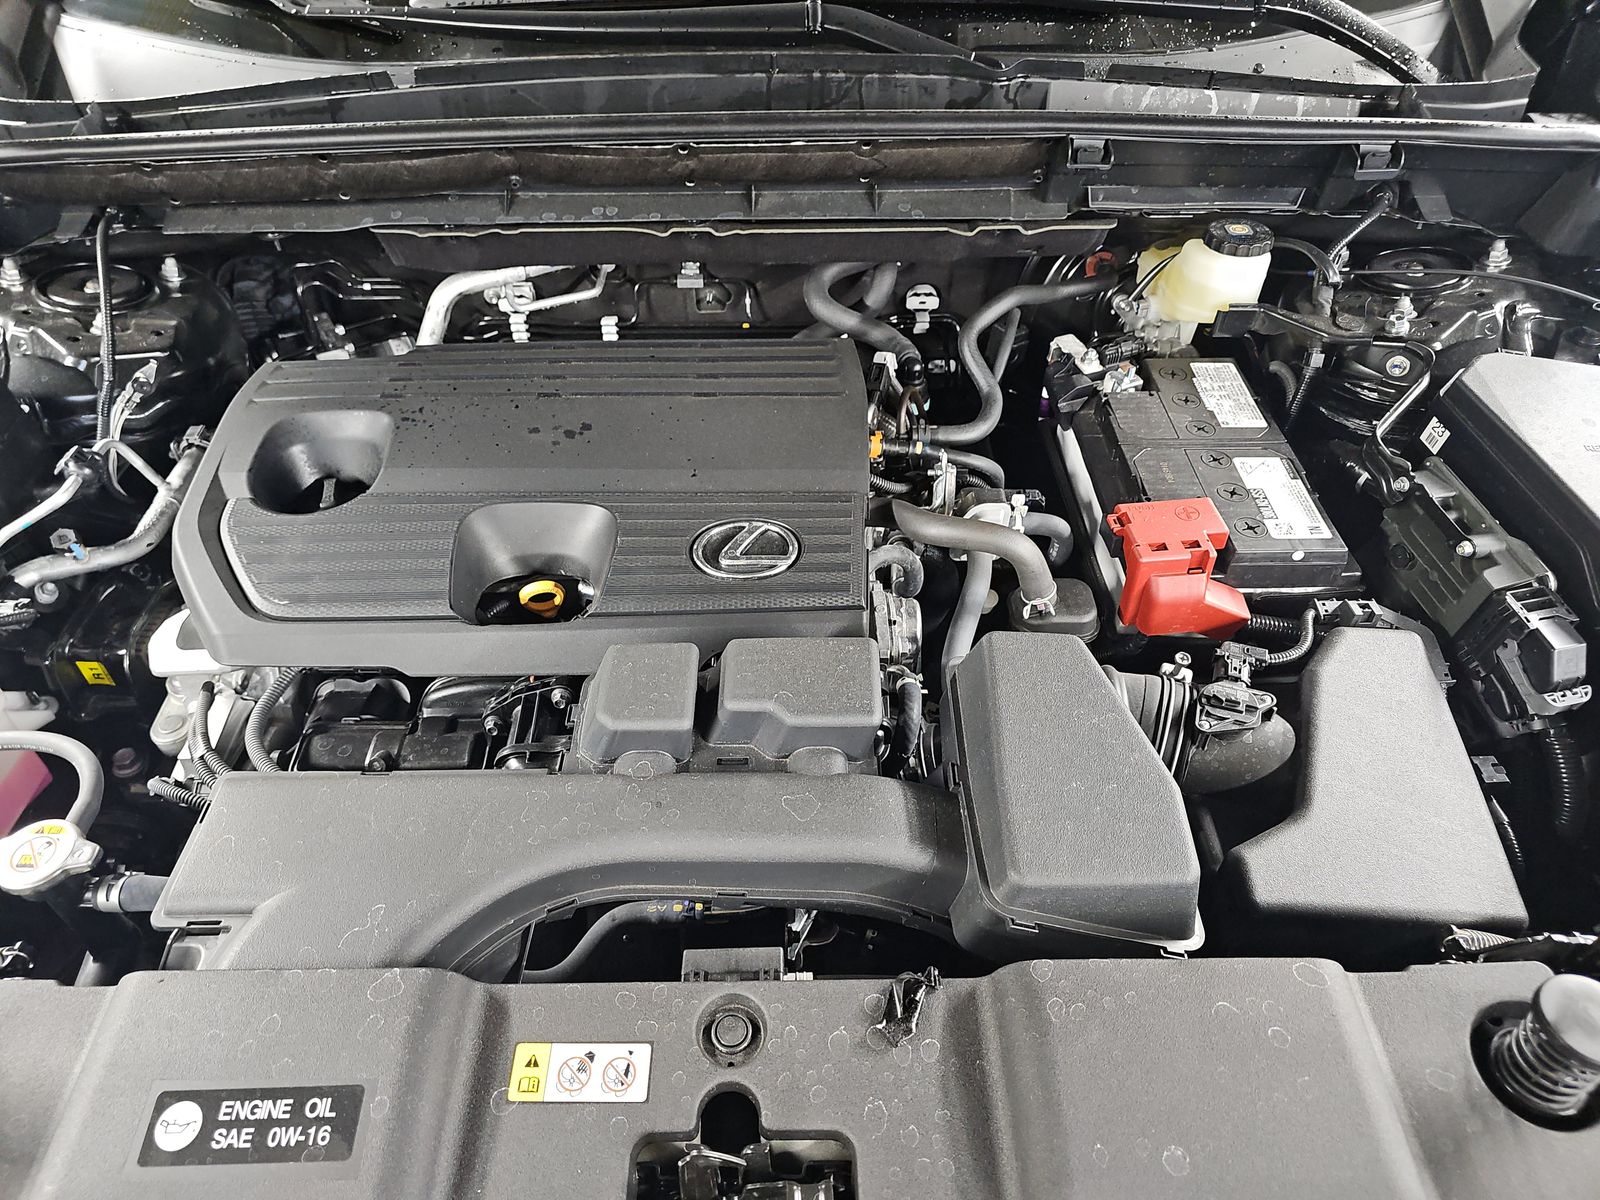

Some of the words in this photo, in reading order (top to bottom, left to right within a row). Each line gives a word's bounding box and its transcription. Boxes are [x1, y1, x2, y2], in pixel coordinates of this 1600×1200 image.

[1431, 420, 1447, 438] 23
[217, 1098, 294, 1121] ENGINE
[304, 1097, 337, 1119] OIL
[210, 1127, 255, 1150] SAE
[267, 1125, 332, 1147] 0W-16
